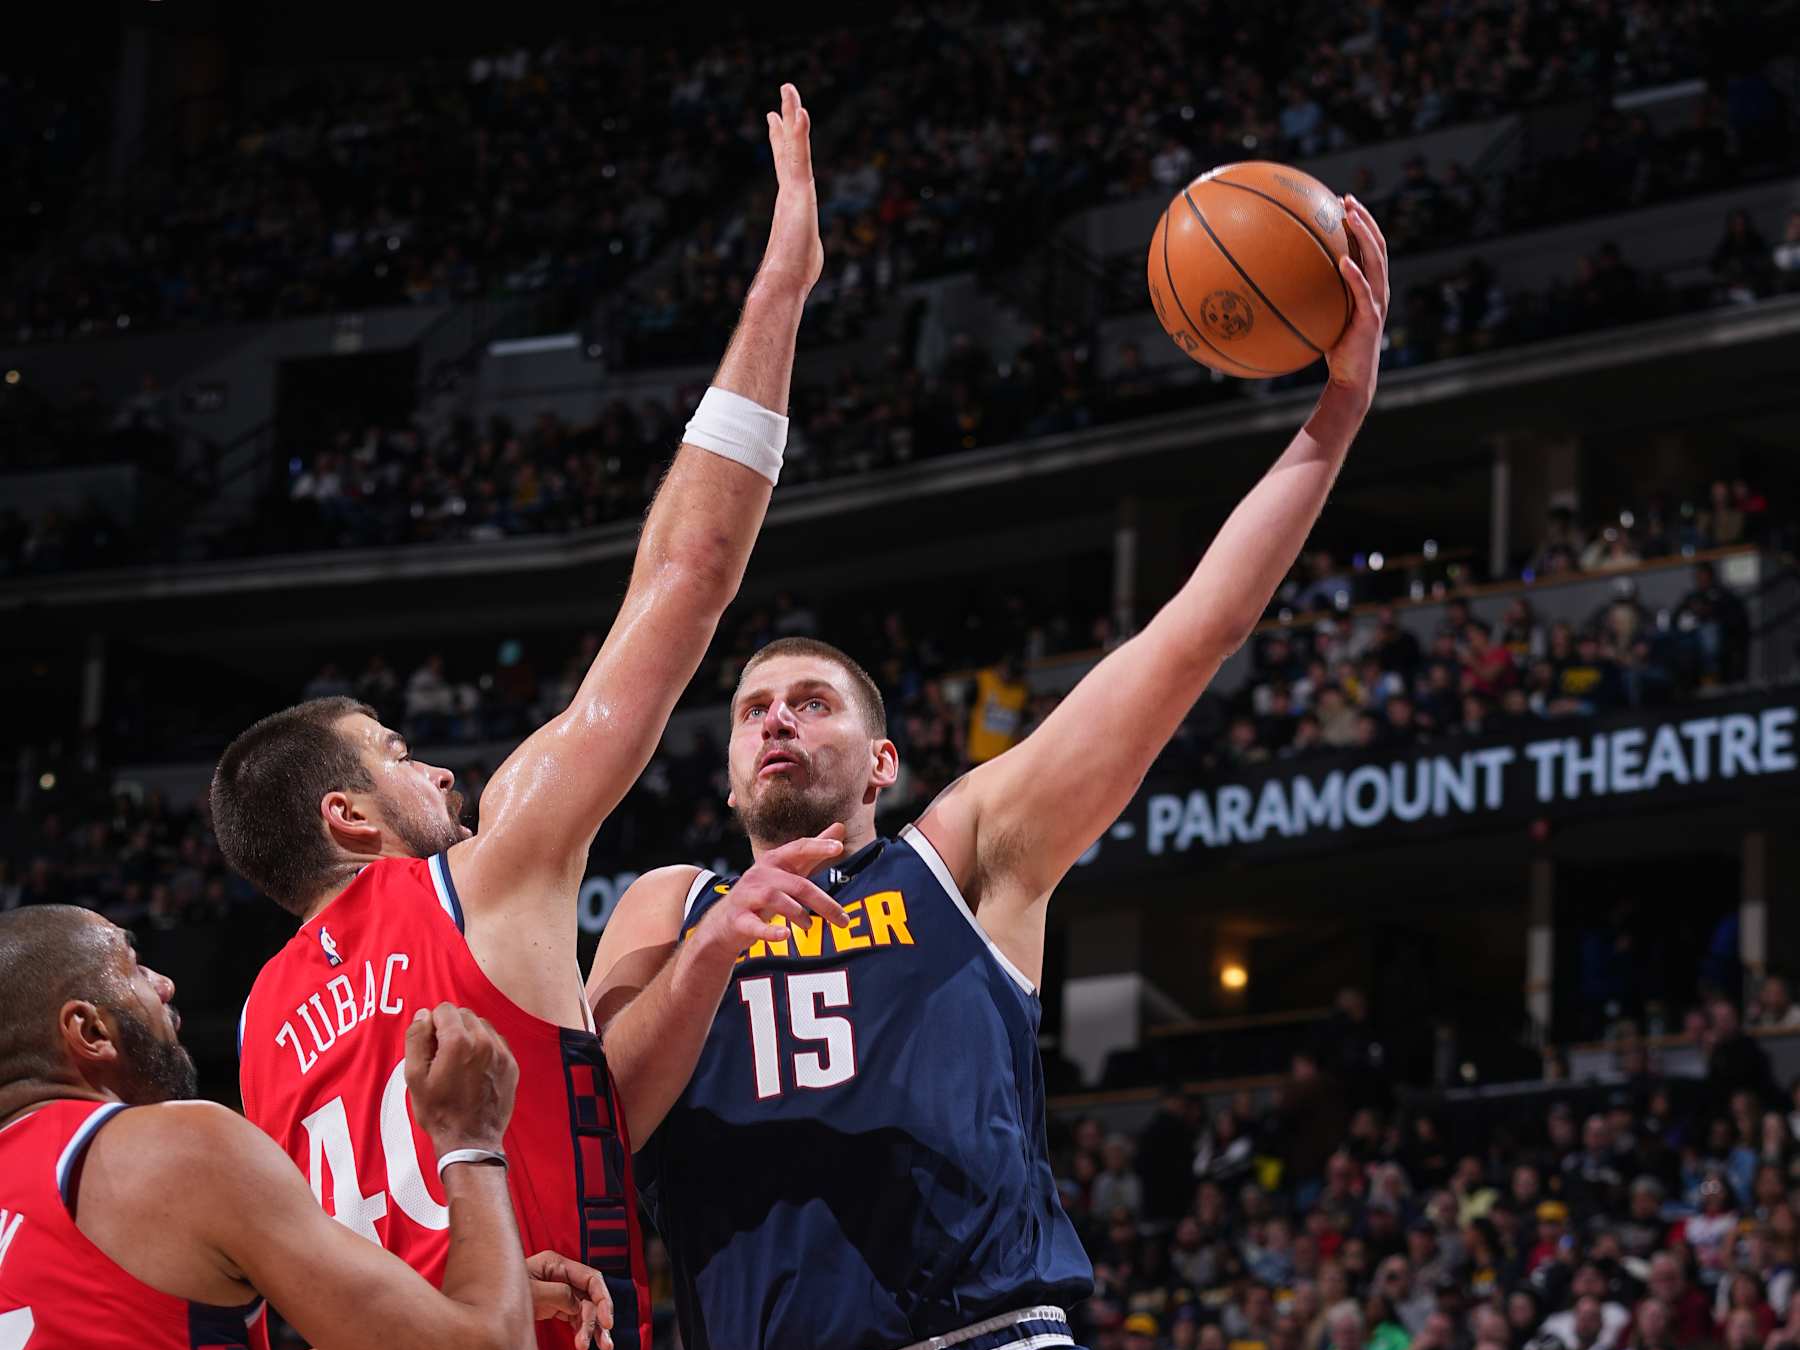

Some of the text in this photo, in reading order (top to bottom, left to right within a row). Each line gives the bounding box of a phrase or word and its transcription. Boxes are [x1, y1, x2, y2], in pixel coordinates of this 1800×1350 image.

[1147, 745, 1513, 854] PARAMOUNT
[1524, 706, 1797, 802] THEATRE
[275, 952, 409, 1075] ZUBAC
[737, 967, 859, 1103] 15
